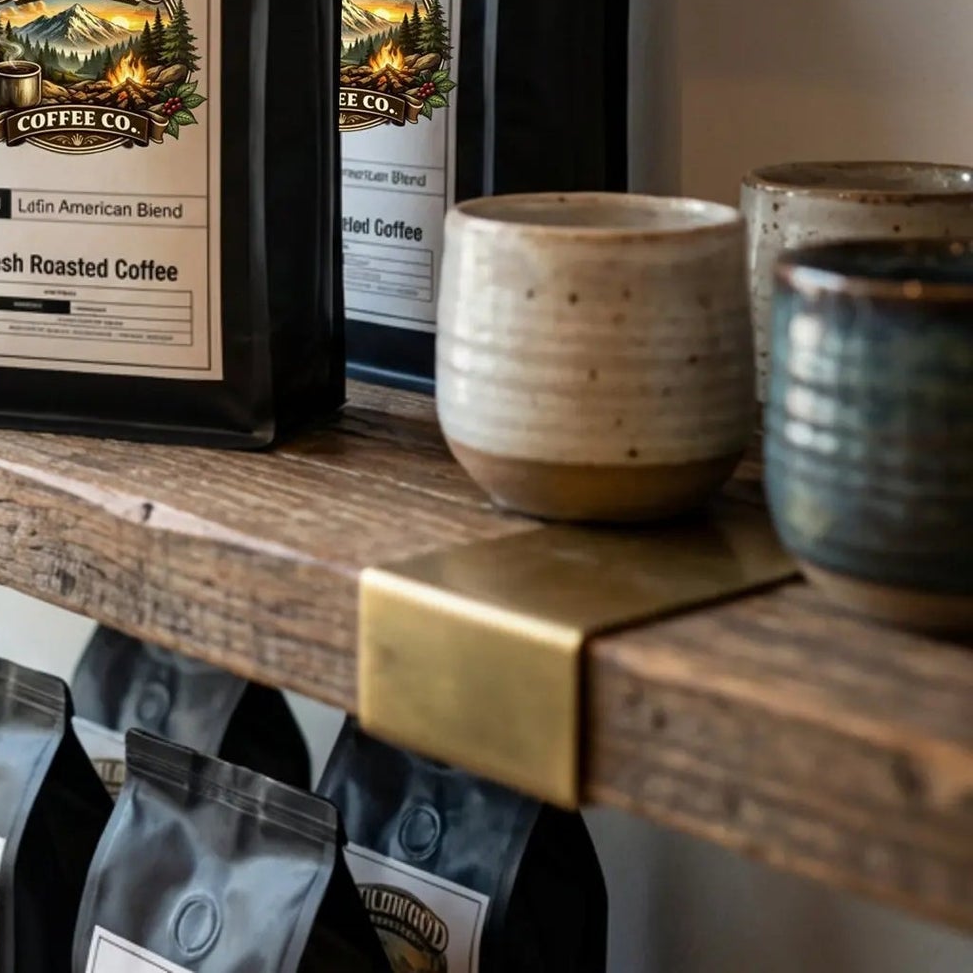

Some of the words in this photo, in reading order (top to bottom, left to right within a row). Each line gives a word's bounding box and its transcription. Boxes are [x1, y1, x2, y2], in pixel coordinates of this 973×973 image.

[17, 110, 96, 132] COFFEE
[59, 199, 132, 217] American
[374, 218, 423, 242] Coffee
[30, 254, 109, 278] Roasted
[115, 258, 179, 281] Coffee
